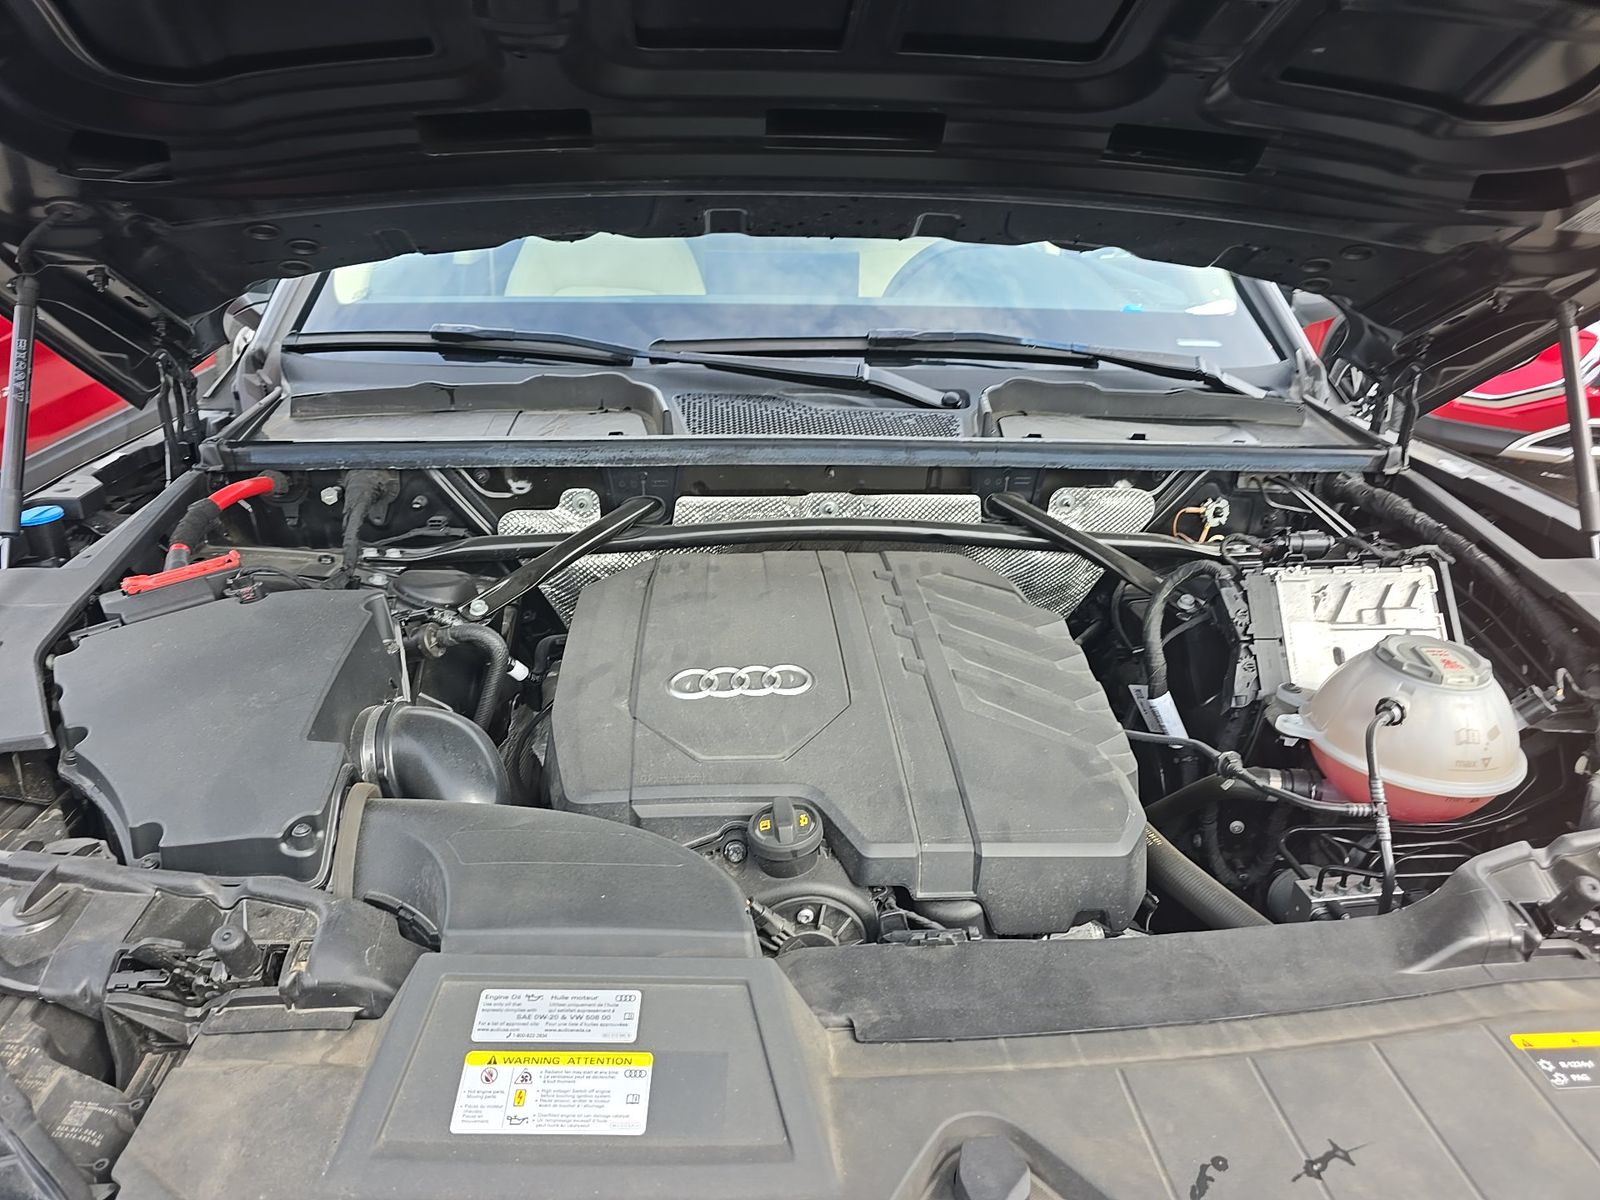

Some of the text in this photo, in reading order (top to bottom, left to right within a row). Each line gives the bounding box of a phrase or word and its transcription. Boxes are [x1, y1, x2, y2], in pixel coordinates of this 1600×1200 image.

[485, 993, 509, 1001] Engine
[503, 1056, 633, 1065] WARNING ATTENTION
